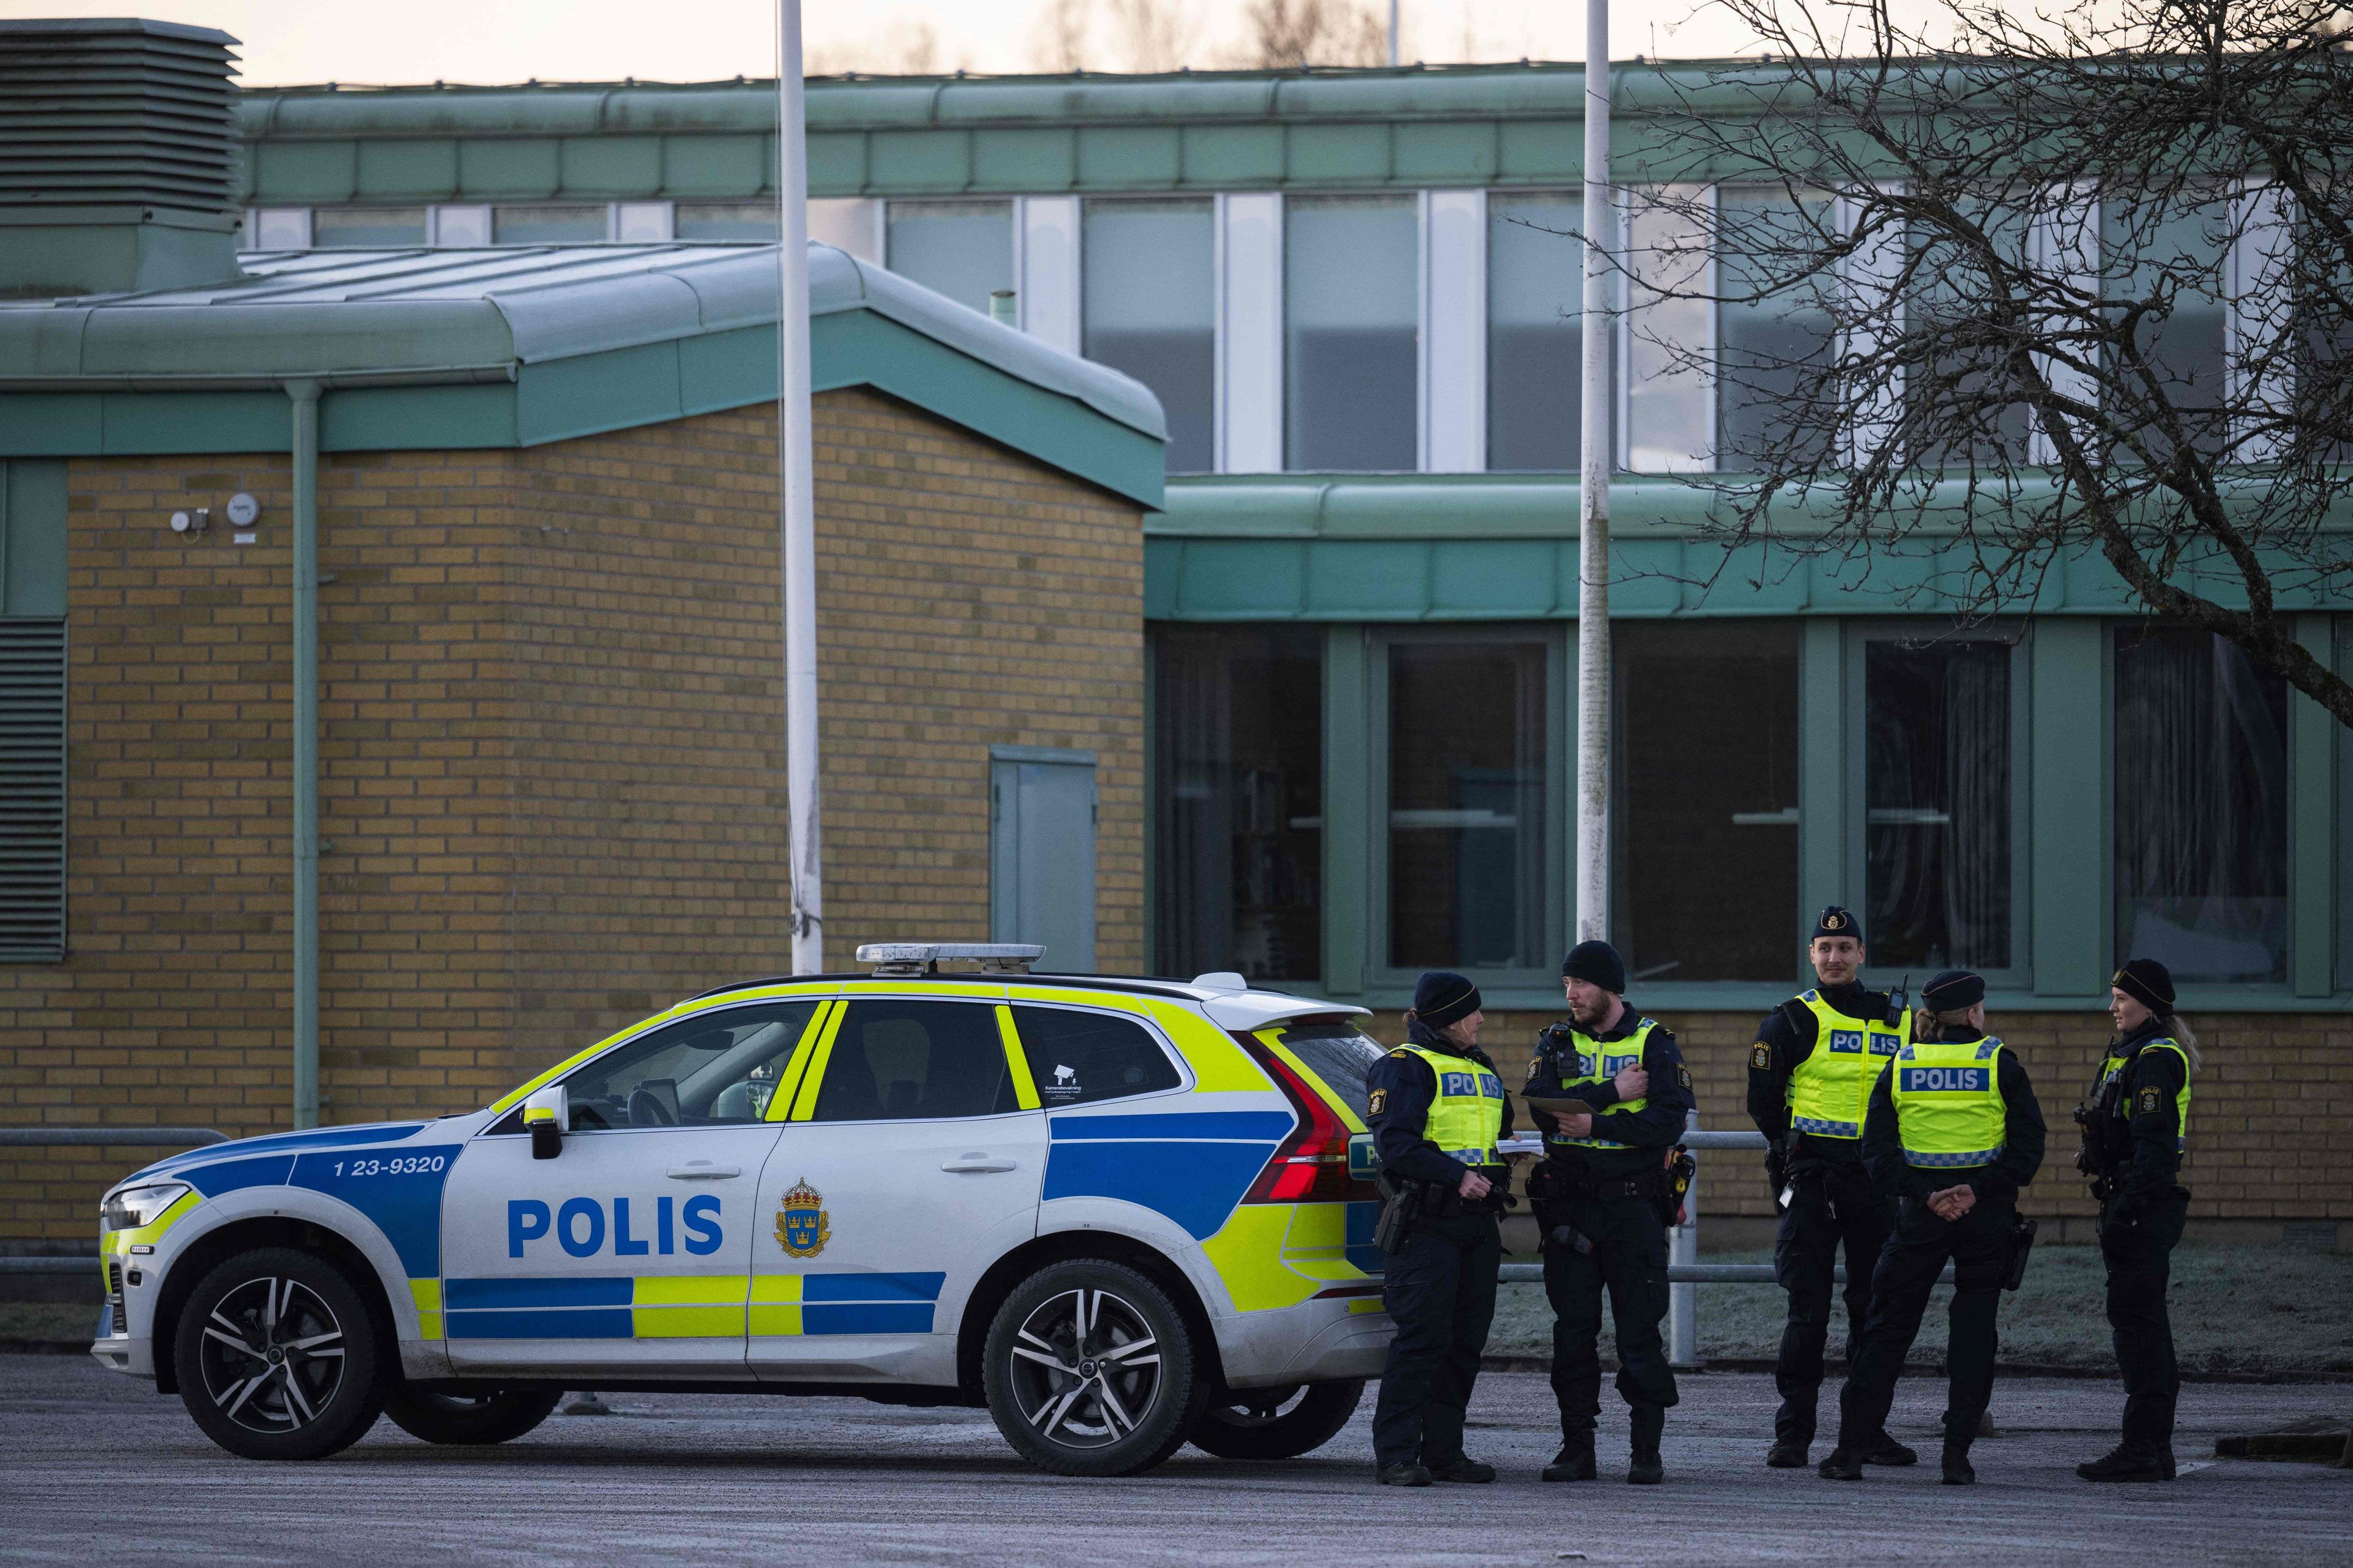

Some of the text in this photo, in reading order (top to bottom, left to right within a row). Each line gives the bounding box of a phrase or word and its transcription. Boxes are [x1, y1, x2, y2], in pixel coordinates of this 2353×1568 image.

[1754, 1043, 1769, 1051] POLIS
[1834, 1033, 1898, 1053] POLIS
[1448, 1073, 1499, 1097] POLIS
[1911, 1069, 1978, 1090] POLIS
[1371, 1090, 1385, 1099] POLIS
[334, 1156, 445, 1176] 1 23-9320
[508, 1195, 723, 1258] POLIS
